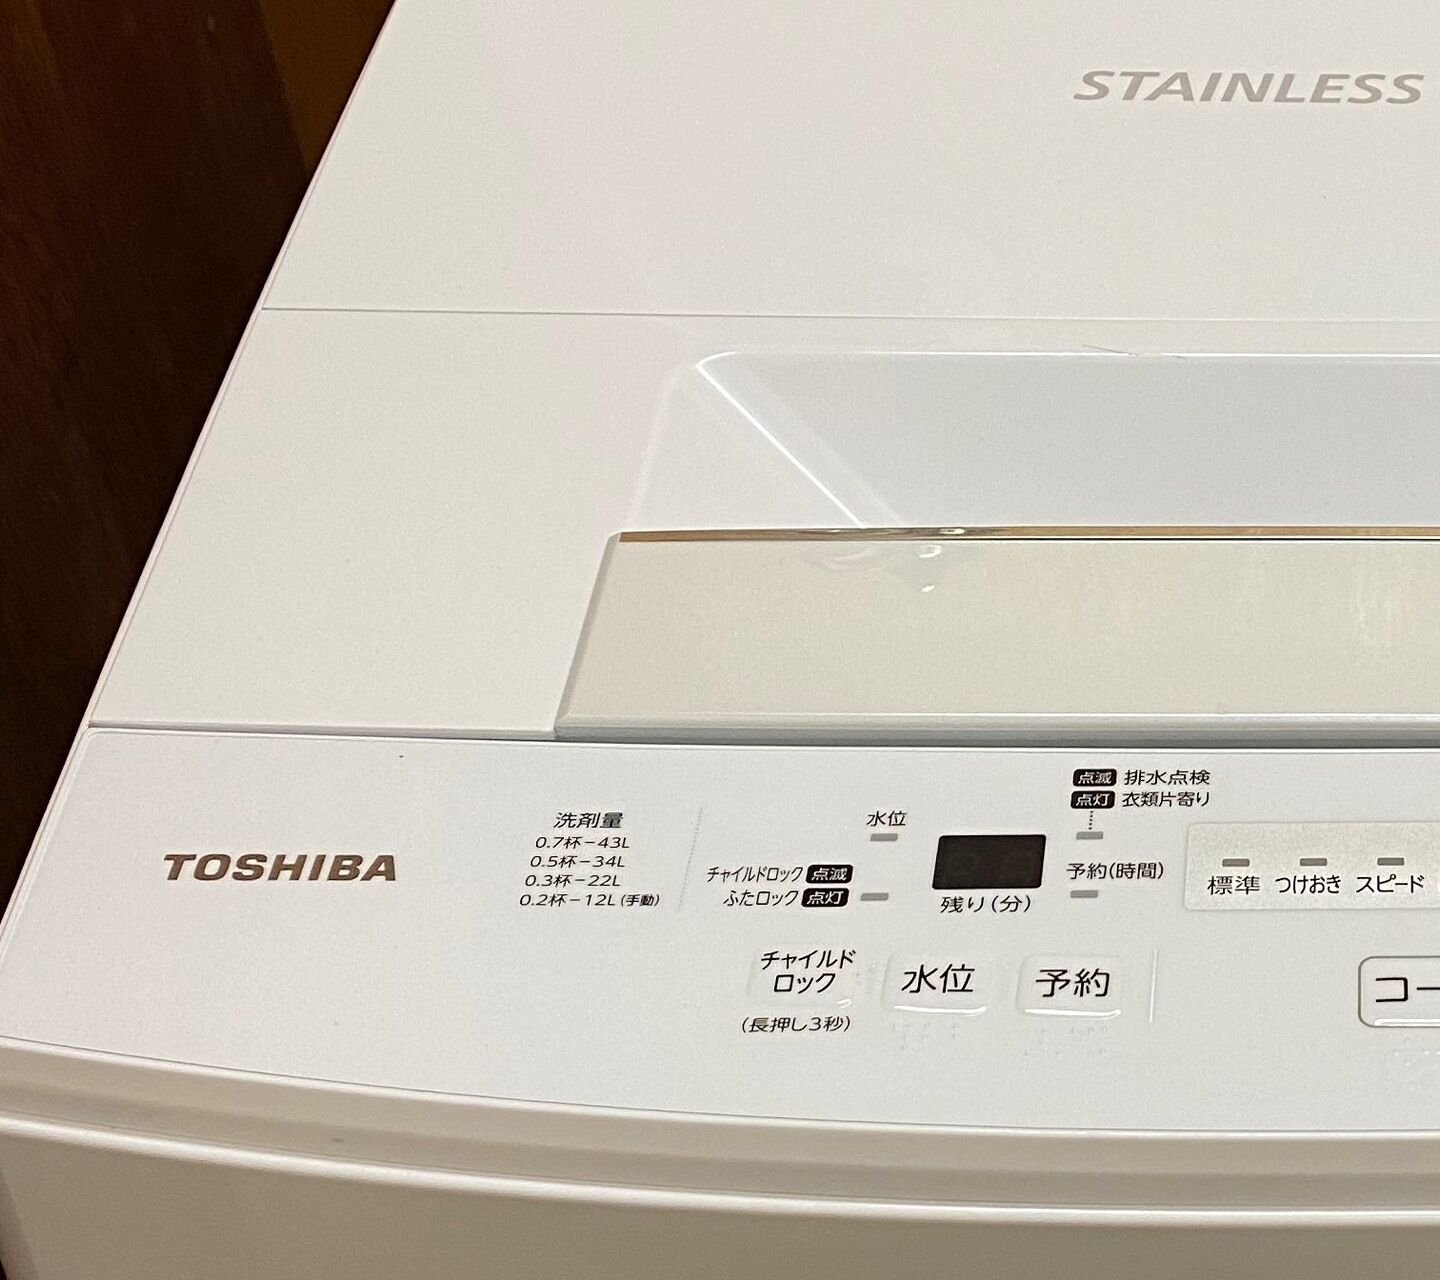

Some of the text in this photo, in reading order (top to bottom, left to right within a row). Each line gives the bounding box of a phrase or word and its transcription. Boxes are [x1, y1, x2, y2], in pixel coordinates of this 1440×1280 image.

[1073, 70, 1425, 104] STAINLESS
[1076, 769, 1211, 785] 点滅 排水点検
[1074, 791, 1209, 807] 点灯 衣類片寄り
[553, 812, 623, 828] 洗剤量
[867, 811, 906, 826] 水位
[163, 853, 396, 882] TOSHIBA
[707, 866, 847, 883] チャイルドロック 点滅
[1207, 876, 1260, 895] 標準
[1275, 876, 1341, 895] つけおき
[1356, 874, 1424, 893] スピード
[724, 890, 843, 906] ふたロック 点灯
[761, 950, 856, 970] チャイルド
[773, 972, 836, 994] ロック
[901, 963, 976, 994] 水位
[1036, 967, 1110, 997] 予約
